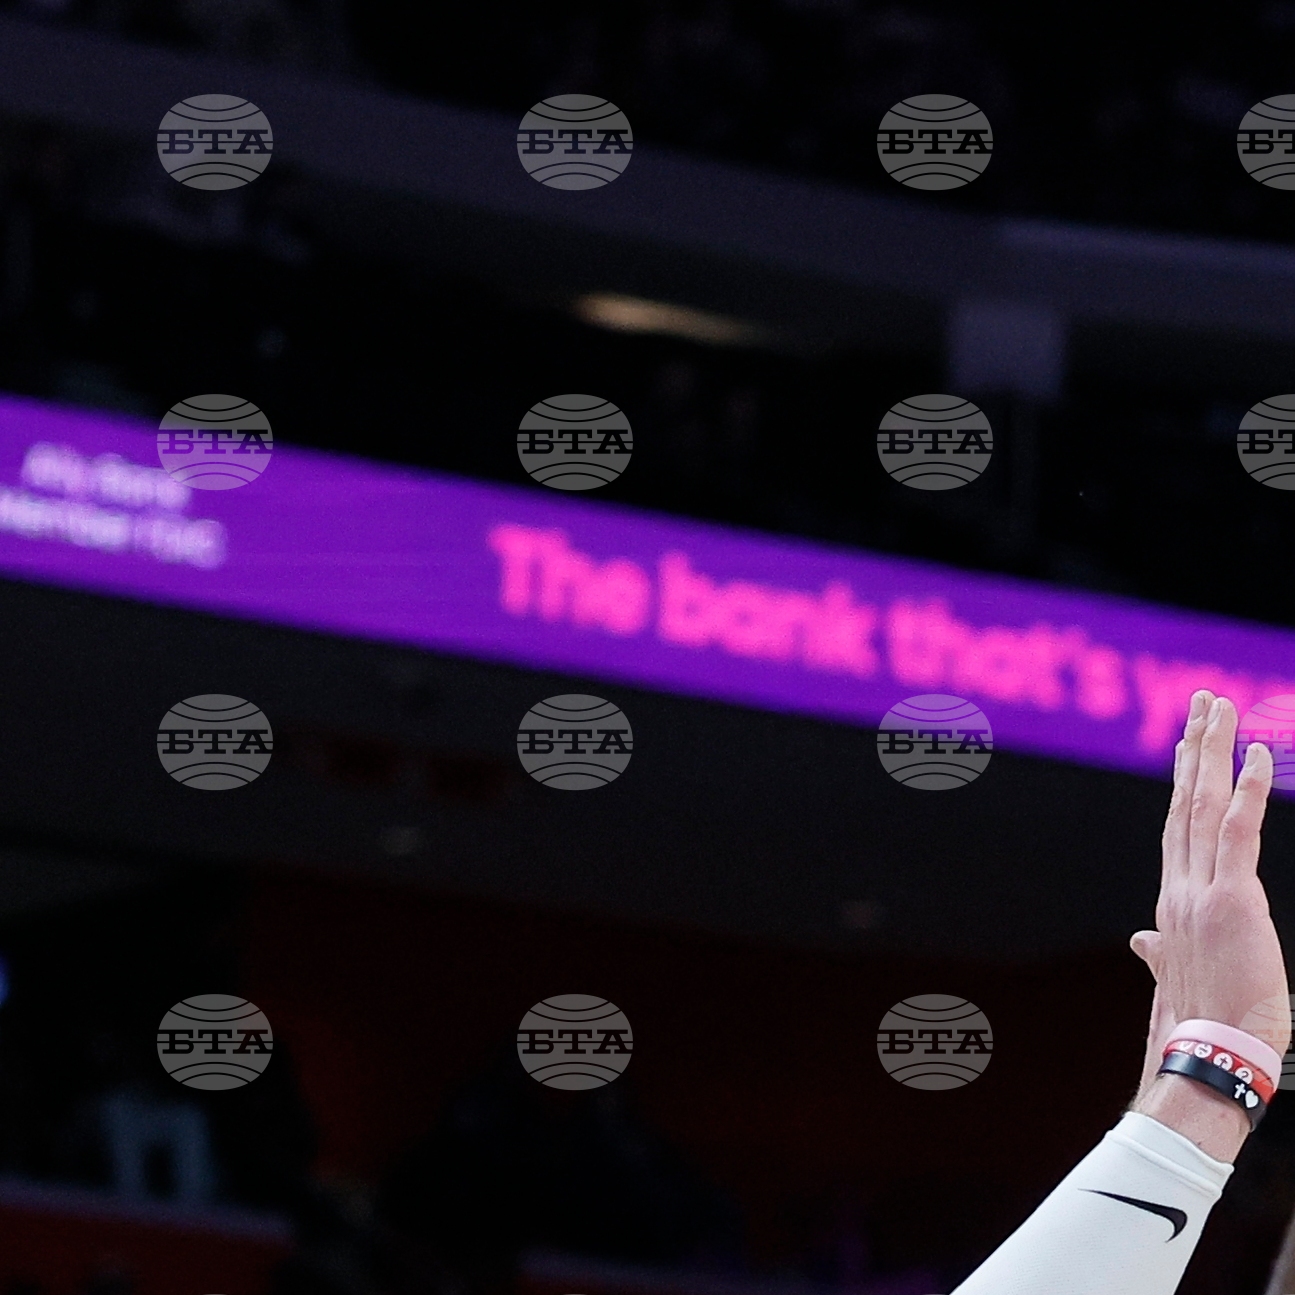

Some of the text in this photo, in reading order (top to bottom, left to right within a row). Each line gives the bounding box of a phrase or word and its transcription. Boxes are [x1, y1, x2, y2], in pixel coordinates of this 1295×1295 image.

[487, 522, 651, 639] The
[657, 548, 879, 681] bank
[887, 597, 1129, 722] that's
